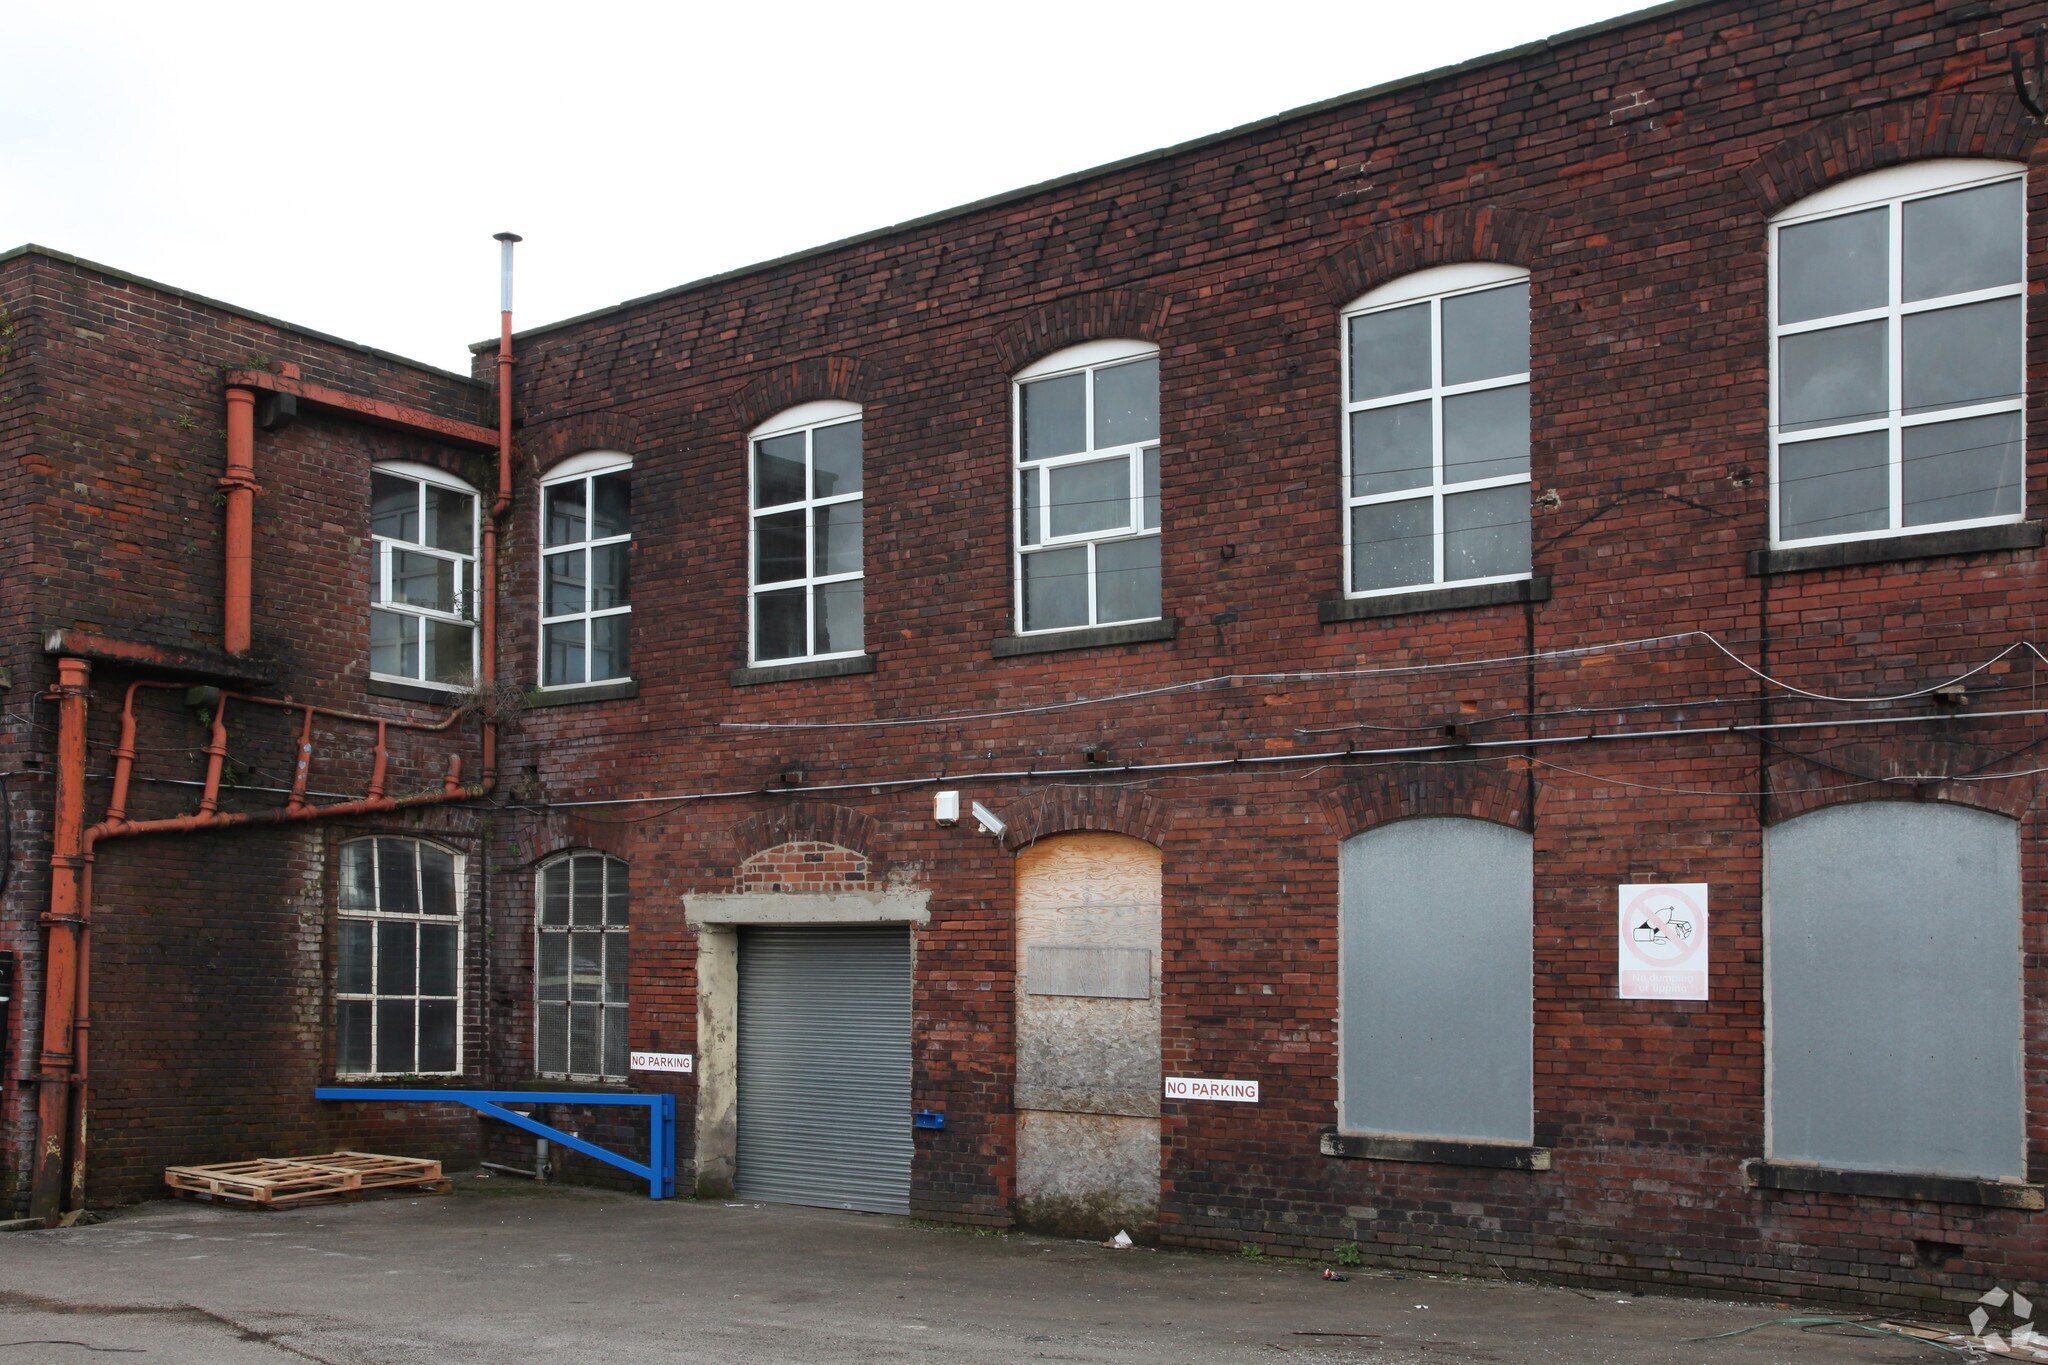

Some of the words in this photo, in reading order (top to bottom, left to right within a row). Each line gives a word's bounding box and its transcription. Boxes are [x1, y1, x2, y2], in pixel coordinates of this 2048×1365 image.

[1632, 973, 1646, 982] No
[1649, 973, 1694, 984] dumping
[1639, 984, 1648, 992] or
[1652, 983, 1687, 994] tipping
[632, 1056, 645, 1066] NO
[648, 1057, 690, 1068] PARKING
[1167, 1082, 1187, 1095] NO
[1192, 1083, 1256, 1098] PARKING
